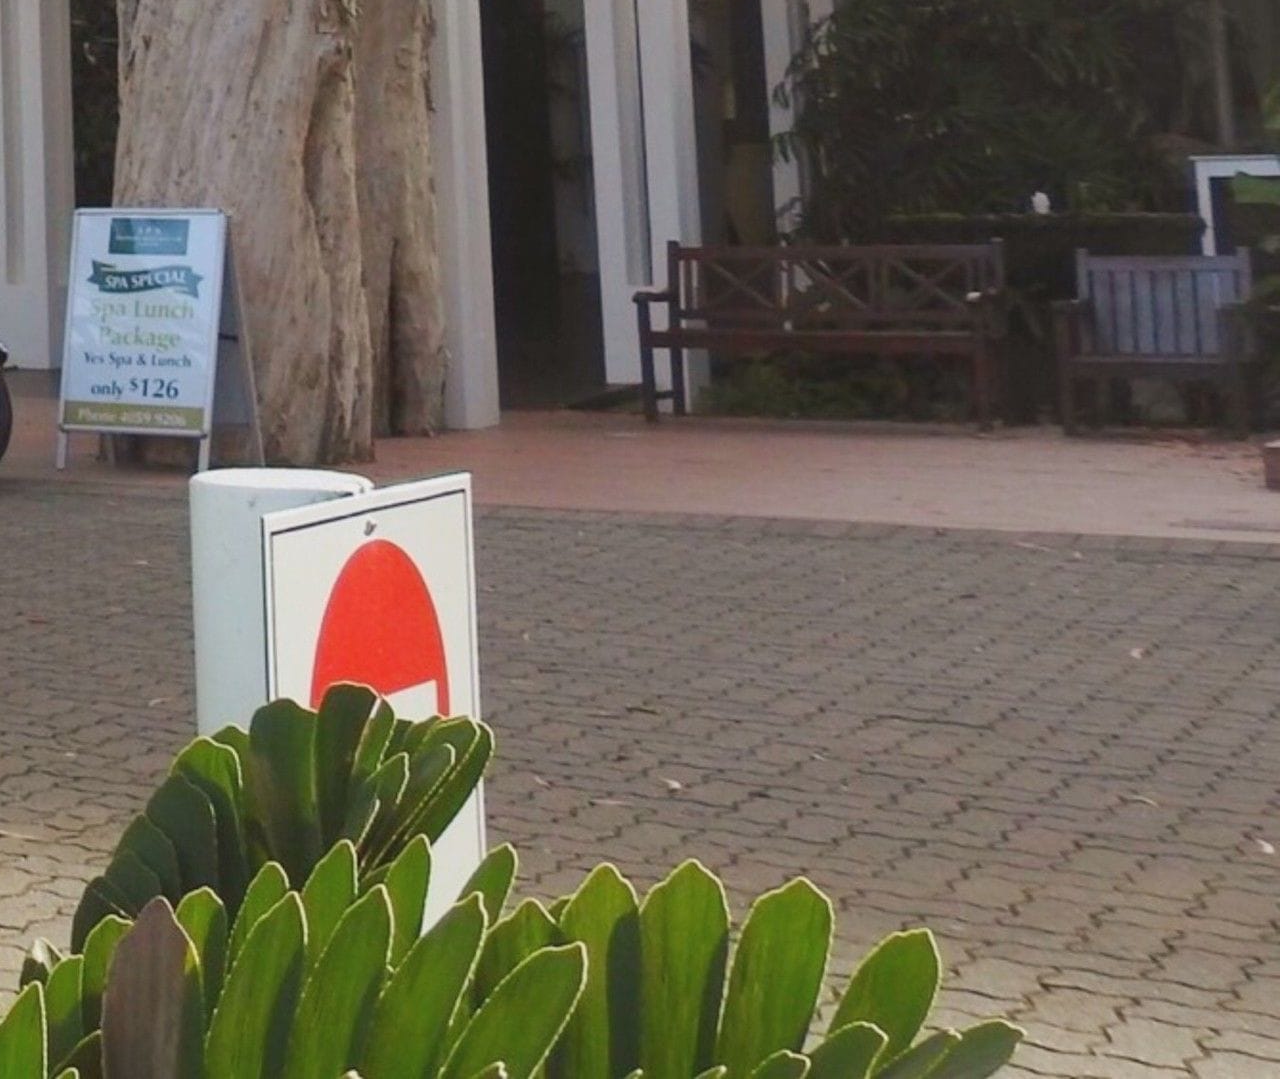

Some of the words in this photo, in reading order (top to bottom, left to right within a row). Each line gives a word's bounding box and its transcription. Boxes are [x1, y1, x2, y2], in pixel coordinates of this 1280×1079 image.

[105, 273, 128, 290] SPA
[131, 269, 186, 289] SPECIAL
[91, 299, 126, 322] Spa
[134, 299, 195, 319] Lunch
[100, 325, 182, 352] Package
[109, 351, 133, 368] Spa
[136, 353, 147, 366] &
[151, 353, 192, 368] Lunch
[90, 380, 123, 400] only
[129, 377, 180, 399] $126
